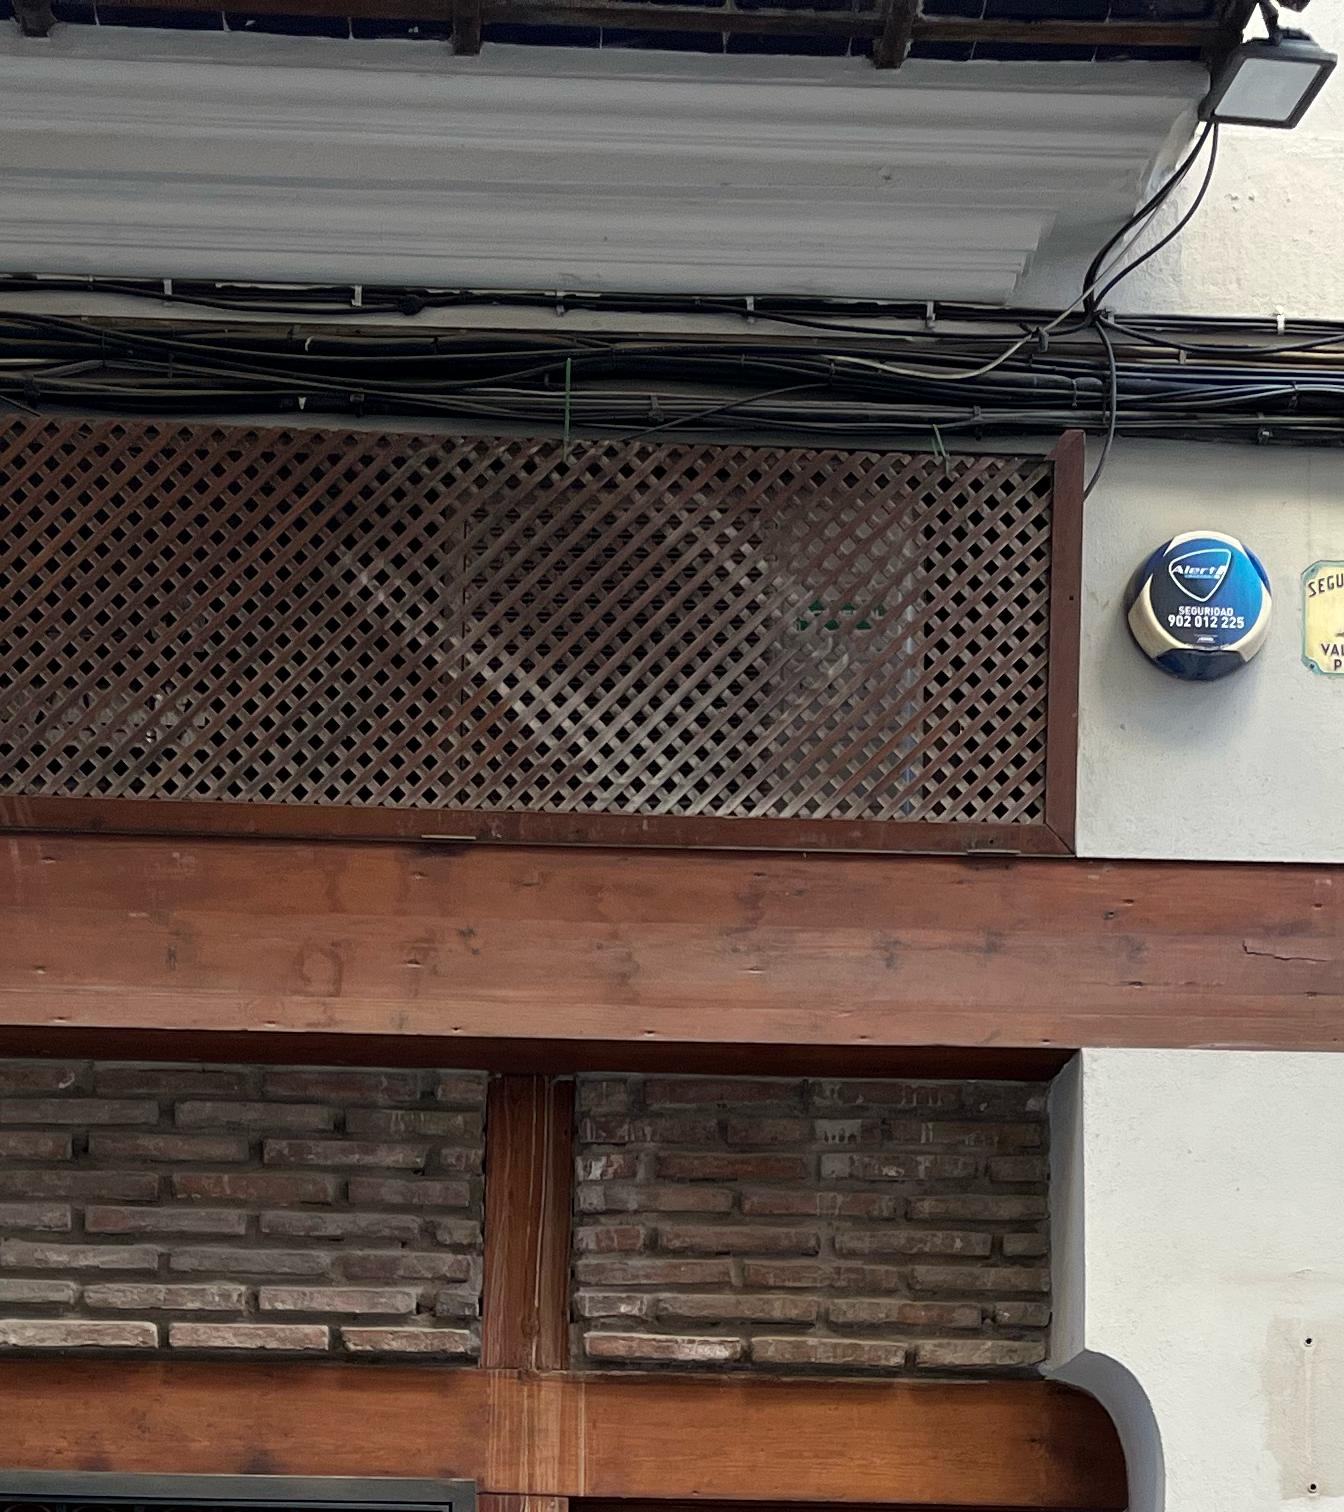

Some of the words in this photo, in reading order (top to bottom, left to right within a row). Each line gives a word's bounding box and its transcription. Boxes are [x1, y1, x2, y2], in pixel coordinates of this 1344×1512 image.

[1178, 605, 1234, 616] SEGURIDAD
[1168, 614, 1192, 627] 902
[1194, 615, 1218, 628] 012
[1221, 616, 1245, 629] 225
